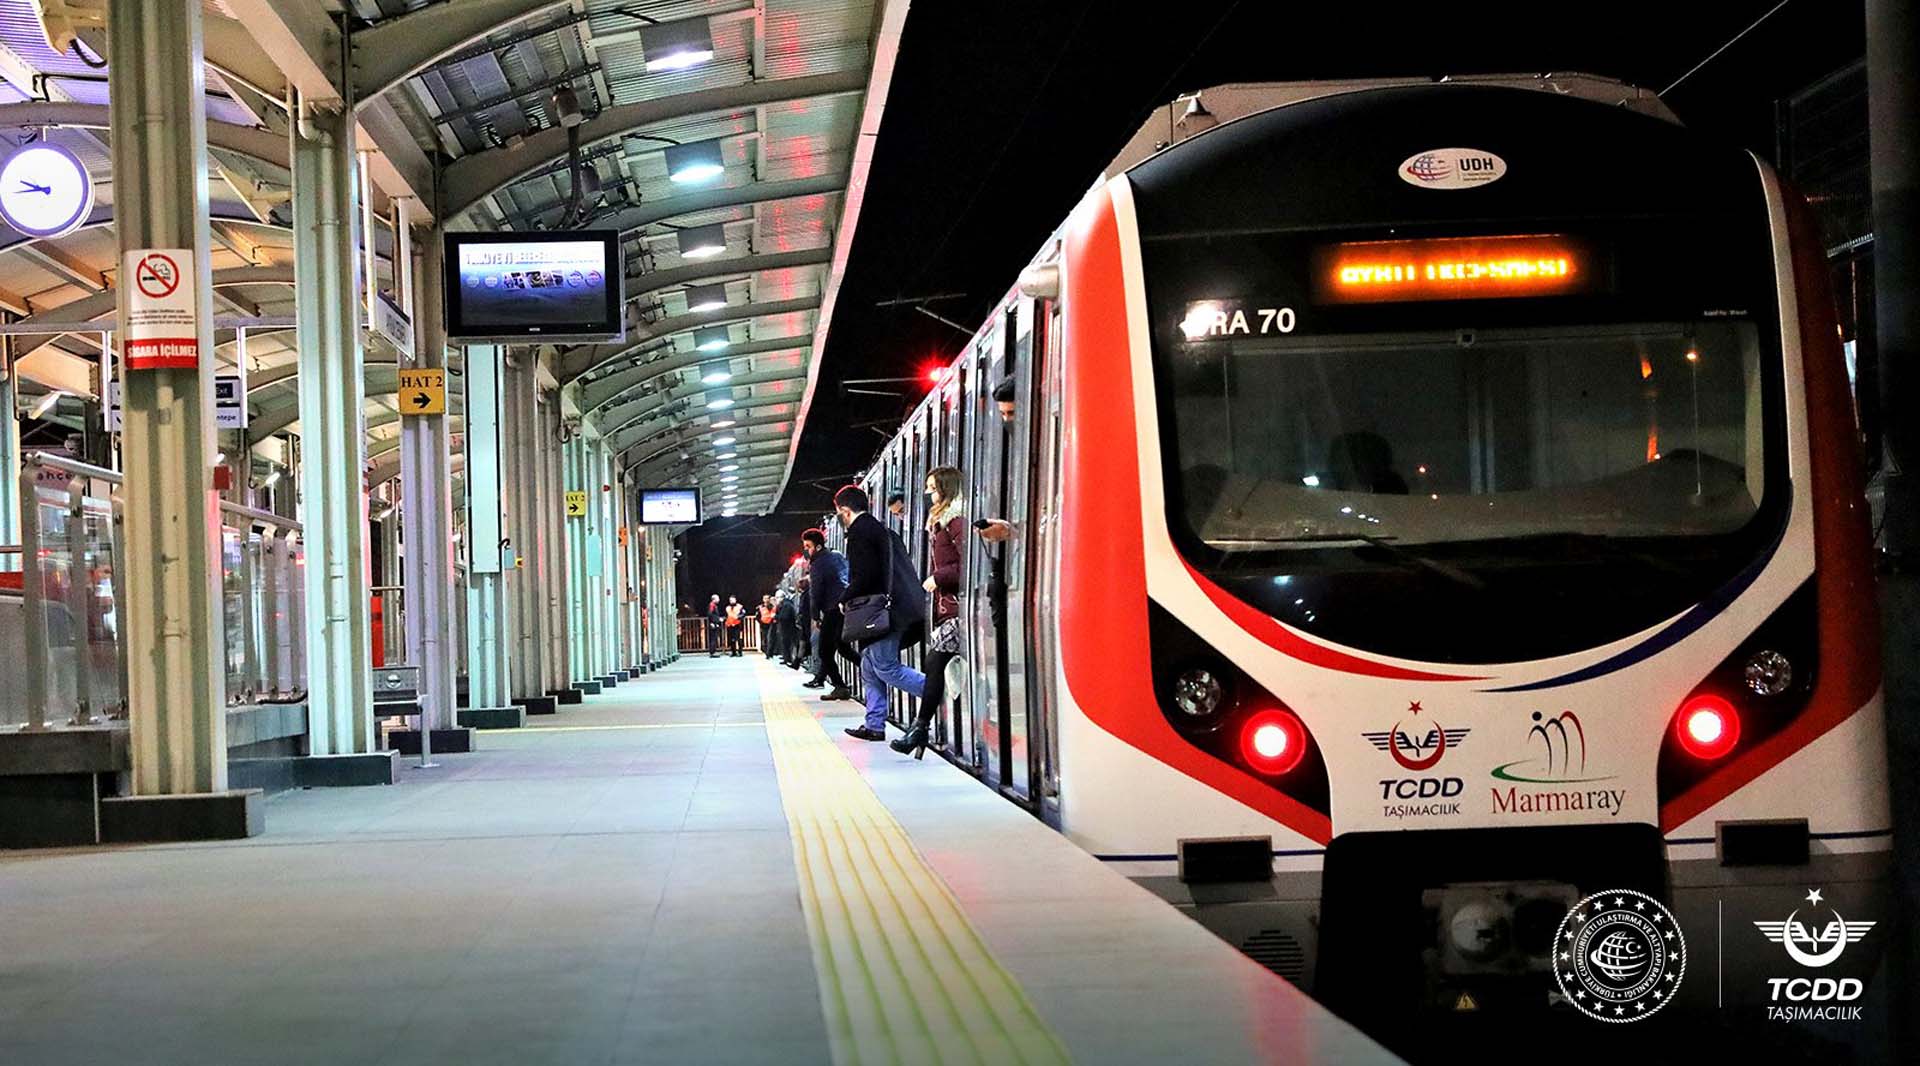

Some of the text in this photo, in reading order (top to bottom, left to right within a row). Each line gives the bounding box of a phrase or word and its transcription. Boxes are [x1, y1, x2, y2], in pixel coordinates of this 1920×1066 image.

[1460, 158, 1494, 171] UDH
[1258, 307, 1296, 334] 70
[401, 376, 442, 388] HAT 2
[1379, 777, 1464, 800] TCDD
[1383, 803, 1461, 819] TAŞIMACILIK
[1491, 787, 1626, 816] Marmaray
